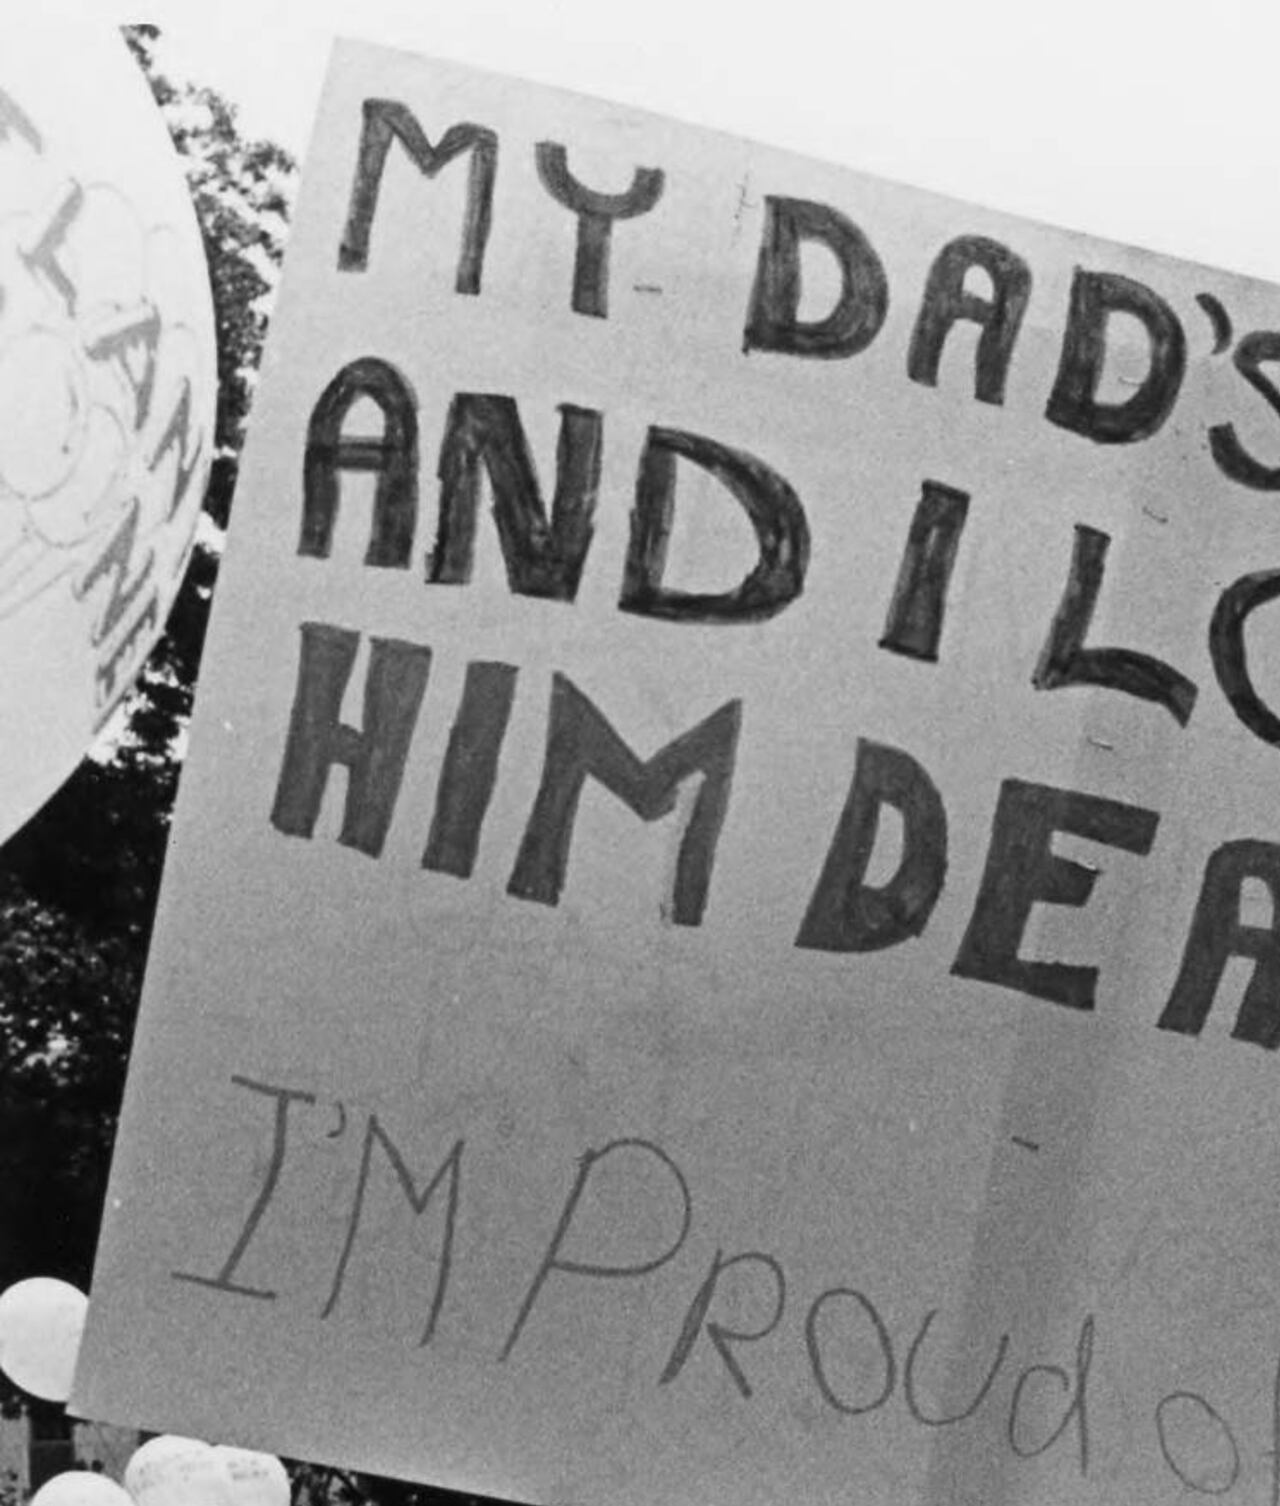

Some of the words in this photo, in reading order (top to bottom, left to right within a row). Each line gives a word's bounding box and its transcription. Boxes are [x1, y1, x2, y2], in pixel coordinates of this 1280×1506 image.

[337, 97, 665, 318] MY
[297, 356, 811, 624] AND
[877, 479, 971, 663] I
[269, 621, 743, 929] HIM
[171, 1075, 465, 1348] I'M
